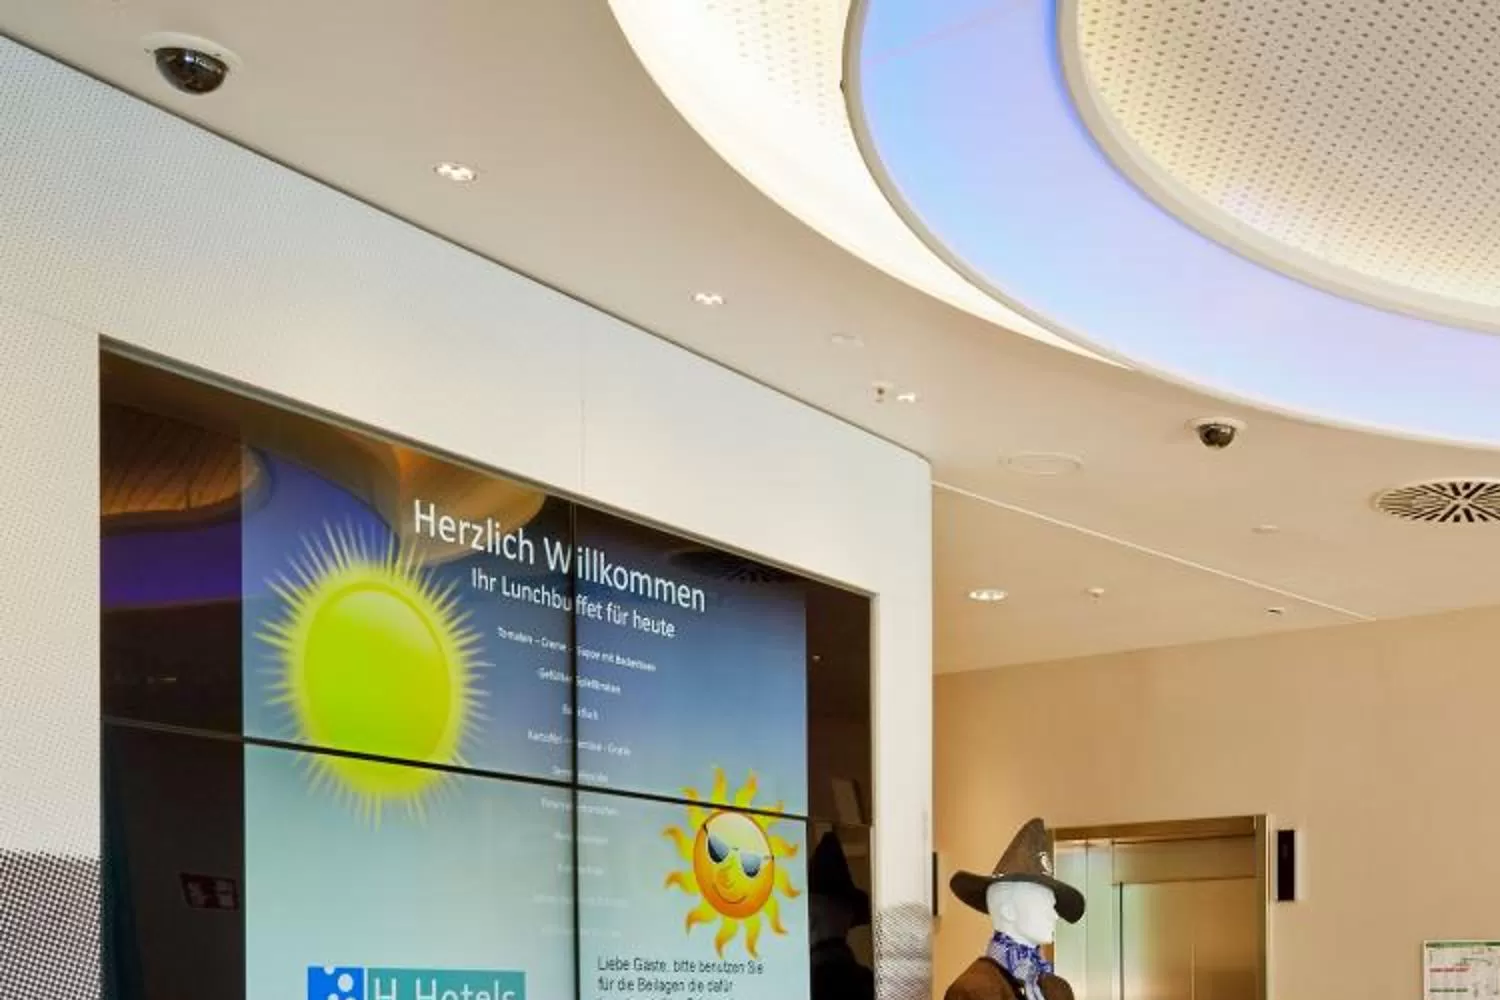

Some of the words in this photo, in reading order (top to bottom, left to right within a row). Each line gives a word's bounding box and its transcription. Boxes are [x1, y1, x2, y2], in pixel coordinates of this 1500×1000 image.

[414, 499, 534, 566] Herzlich
[544, 537, 706, 613] Willkommen
[471, 567, 497, 592] Ihr
[502, 576, 602, 621] Lunchbuffet
[604, 602, 629, 626] für
[633, 609, 677, 638] heute
[597, 956, 631, 971] Liebe
